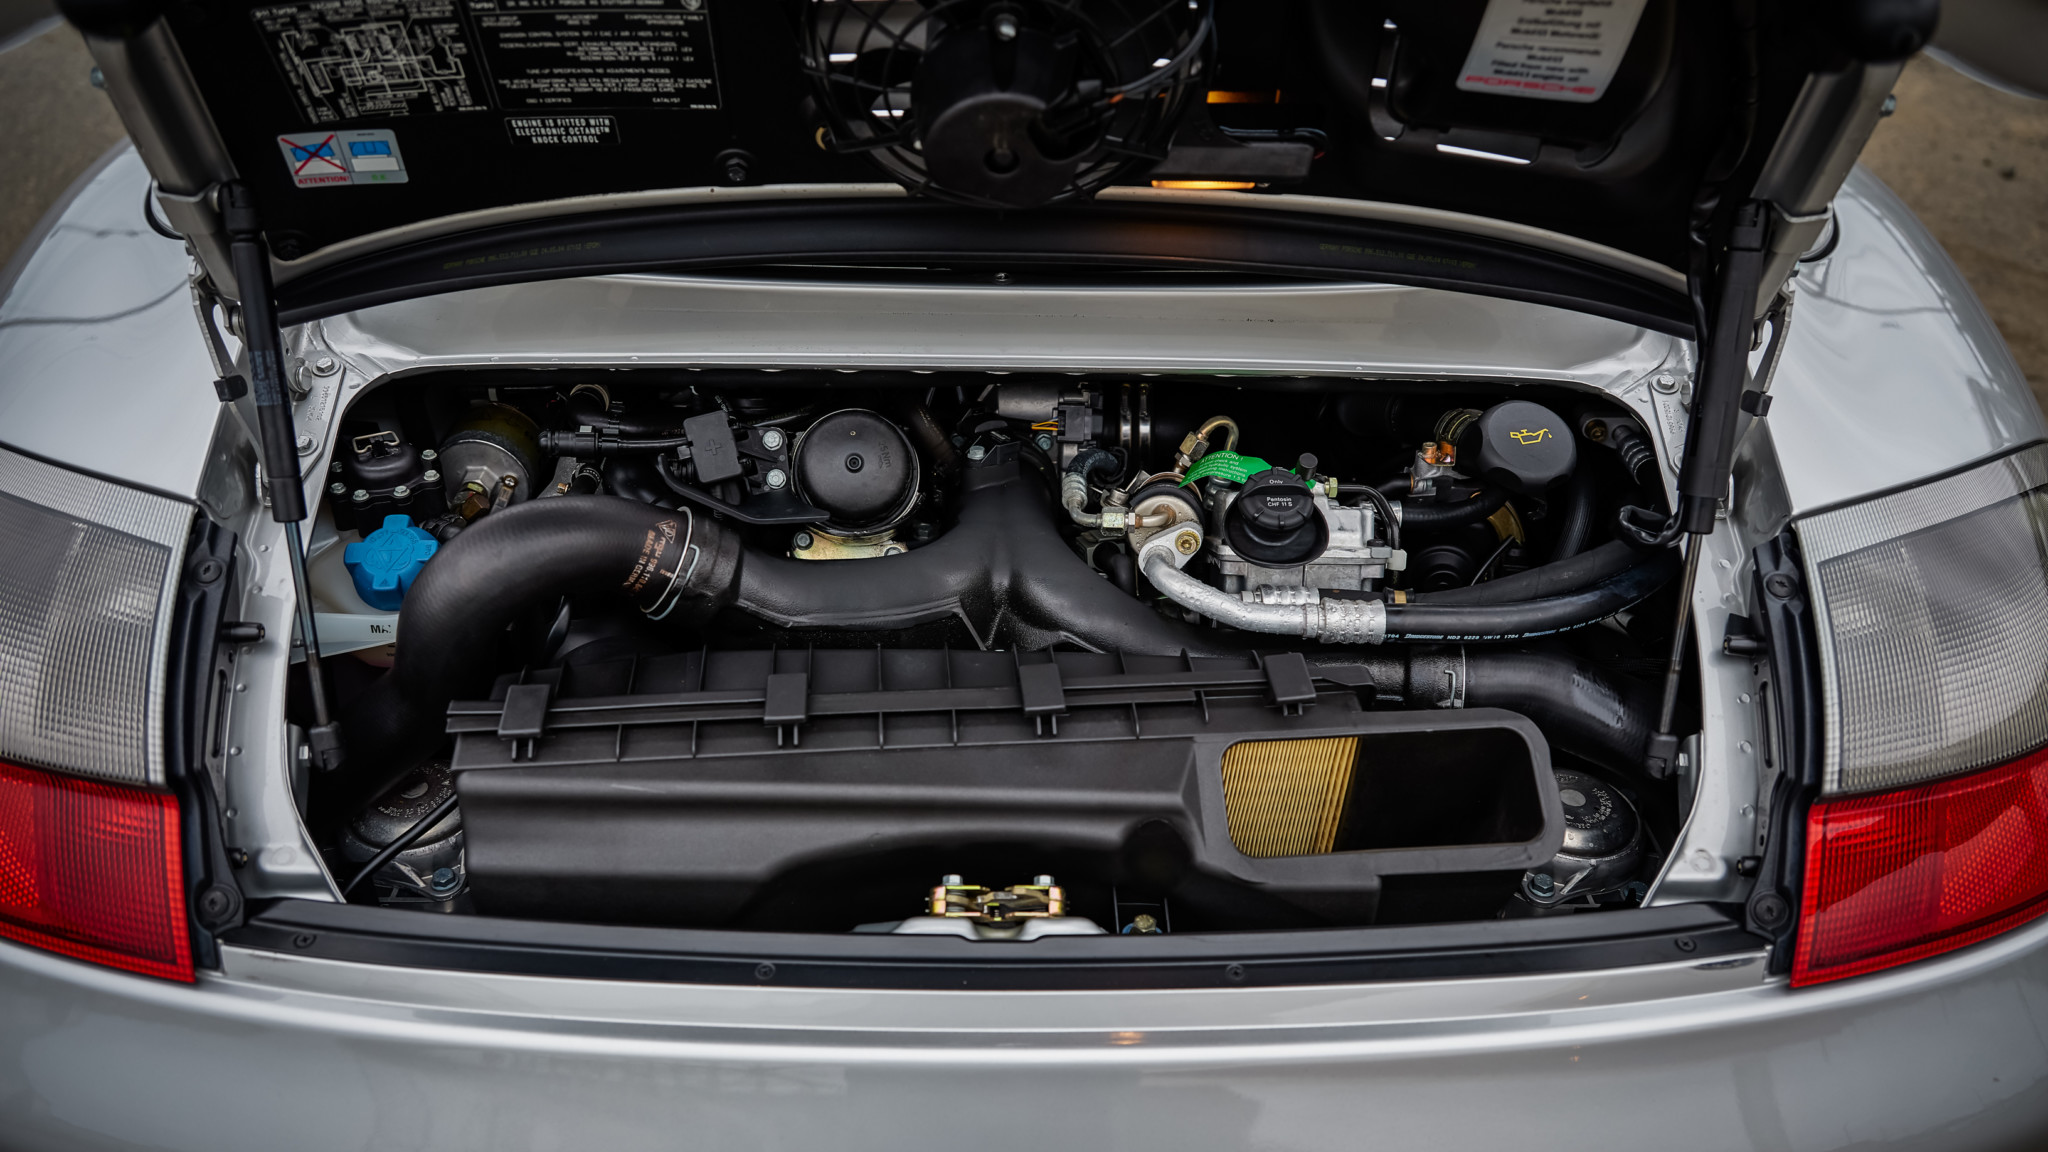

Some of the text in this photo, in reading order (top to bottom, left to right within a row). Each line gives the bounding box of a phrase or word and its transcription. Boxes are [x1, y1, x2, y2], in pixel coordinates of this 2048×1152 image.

[1465, 75, 1596, 95] PORSCHE
[511, 118, 610, 128] ENGINE IS FITTED WITH
[514, 127, 566, 136] ELECTRONIC
[531, 135, 600, 144] KNOCK CONTROL
[297, 175, 351, 186] ATTENTION!
[1200, 452, 1240, 464] ATTENTION
[642, 529, 656, 555] MADE
[370, 624, 392, 634] MA
